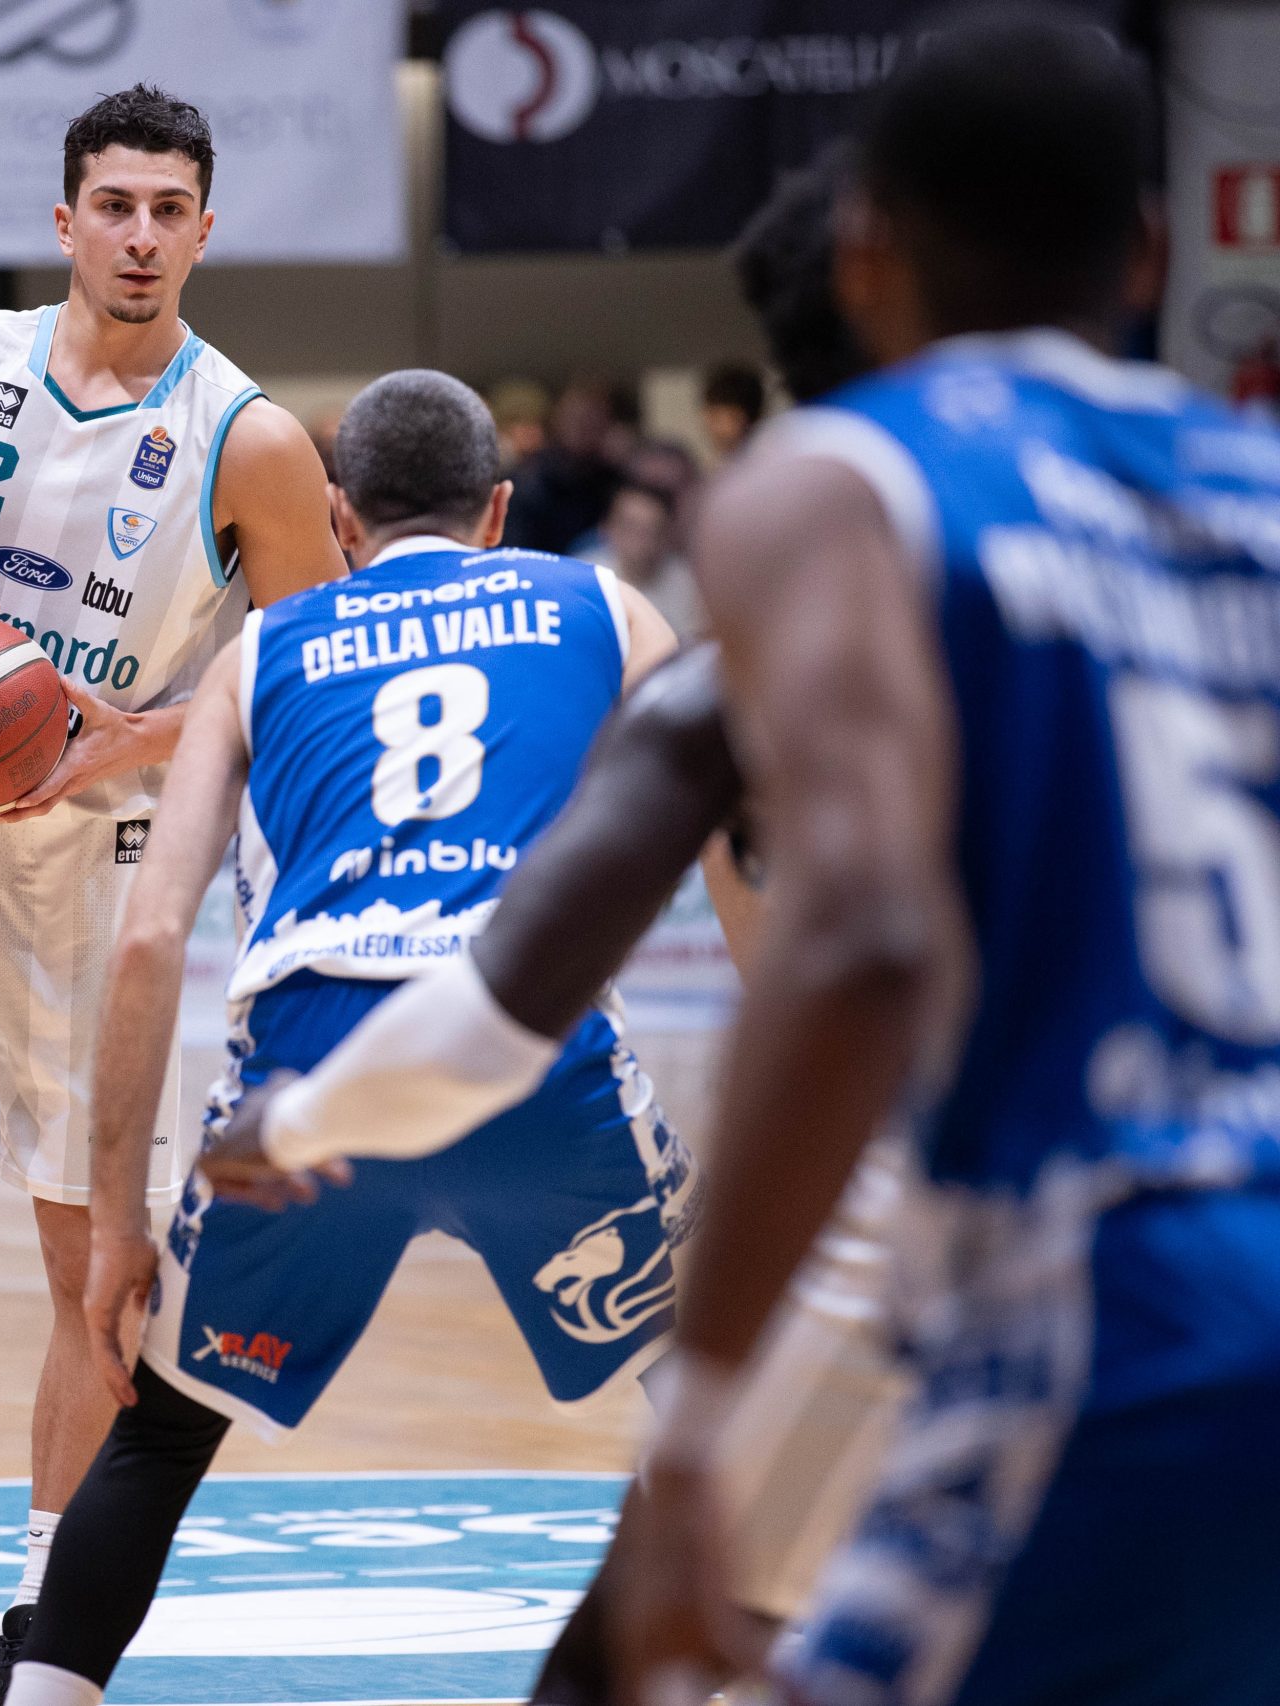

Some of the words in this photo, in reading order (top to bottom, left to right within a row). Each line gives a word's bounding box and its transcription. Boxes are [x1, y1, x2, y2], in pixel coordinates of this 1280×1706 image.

[137, 470, 160, 484] Unipol
[140, 449, 167, 467] LBA
[3, 552, 56, 585] Ford
[81, 571, 133, 618] tabu
[335, 569, 533, 620] bonera.
[301, 616, 429, 685] DELLA
[431, 598, 562, 656] VALLE
[372, 662, 490, 827] 8
[117, 849, 142, 862] erre
[378, 835, 518, 878] inblu
[352, 934, 462, 958] LEONESSA
